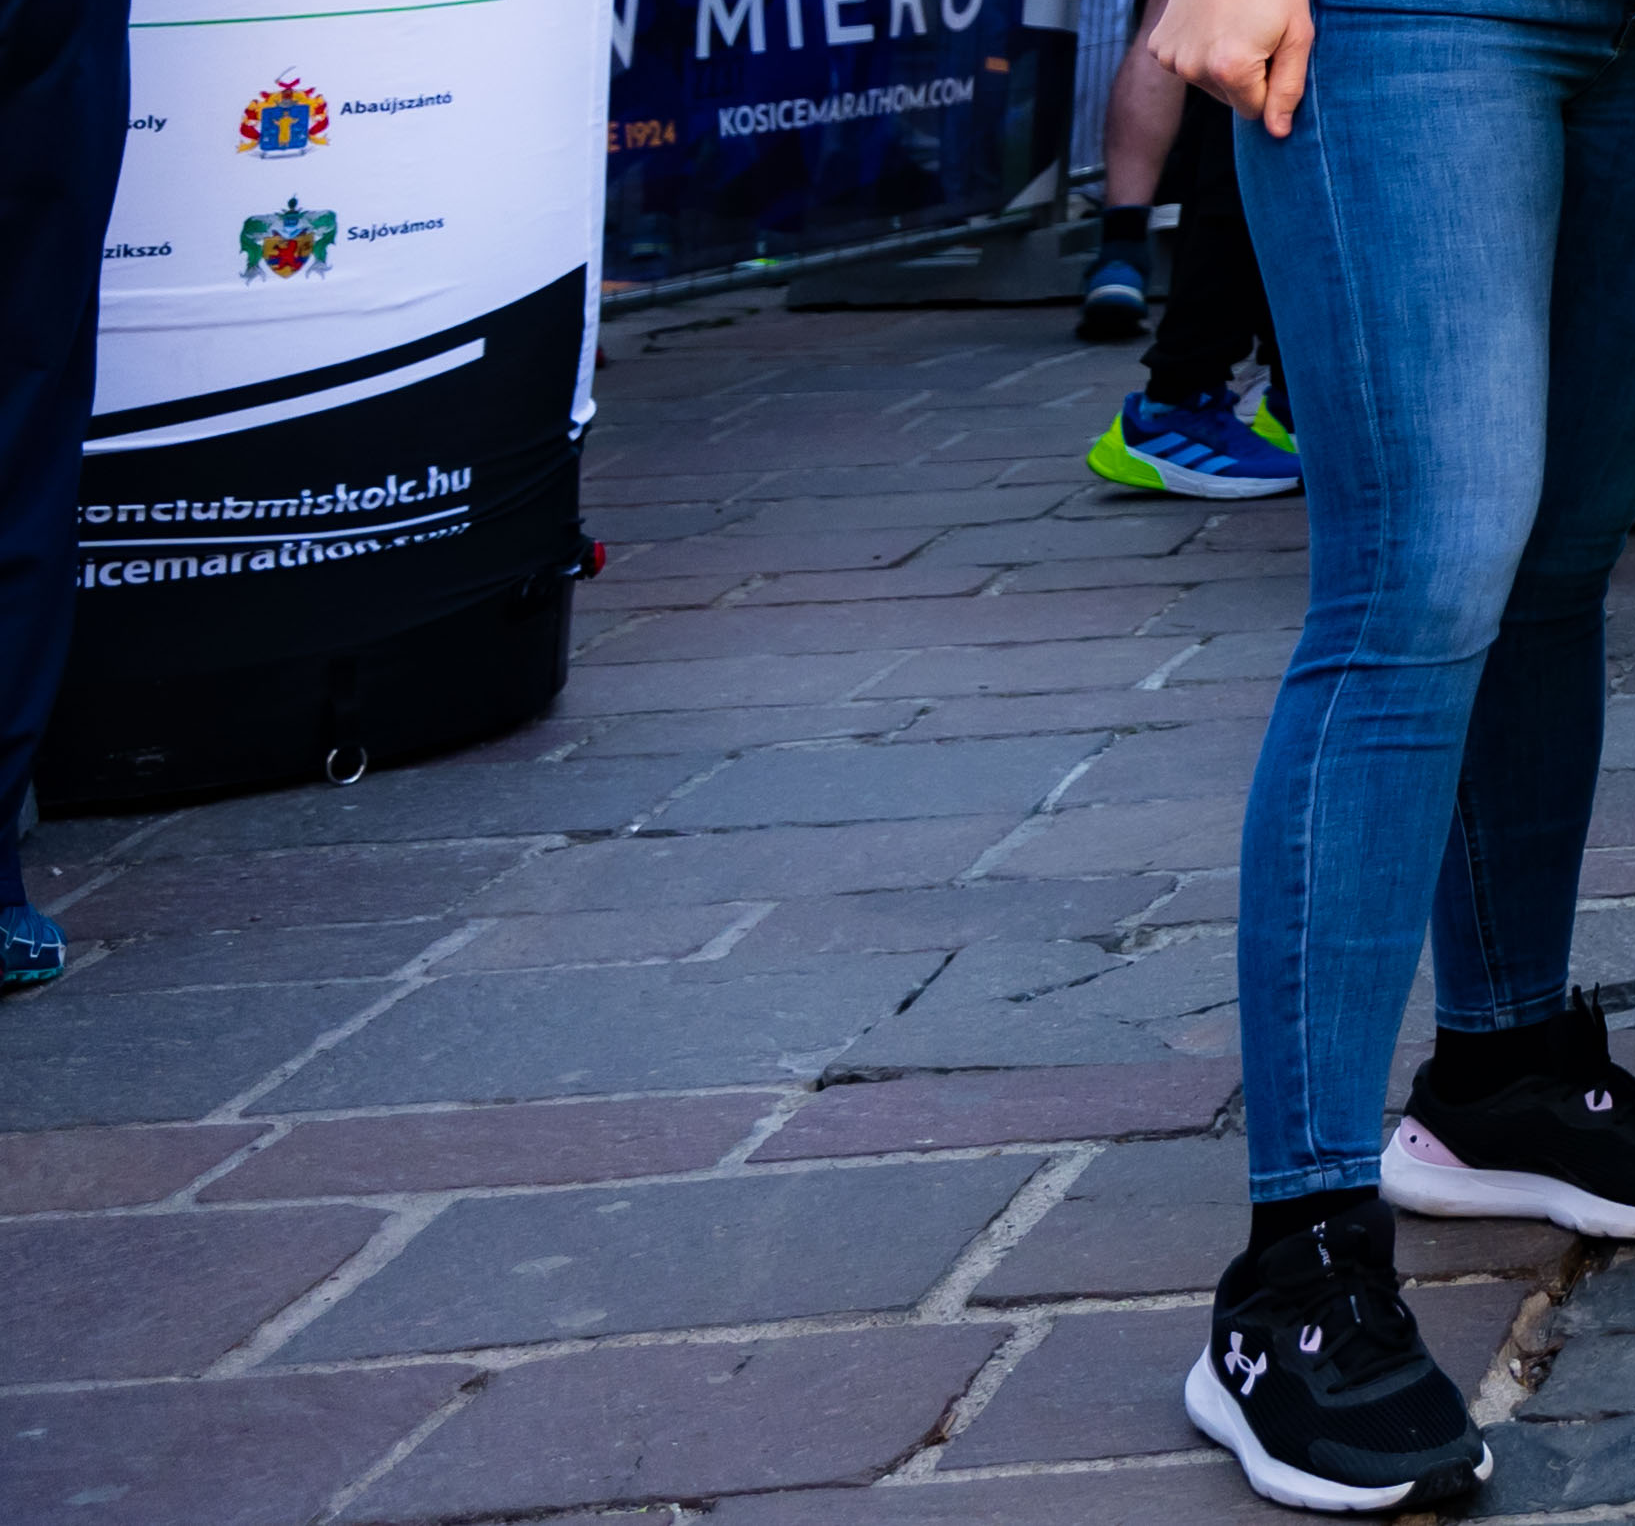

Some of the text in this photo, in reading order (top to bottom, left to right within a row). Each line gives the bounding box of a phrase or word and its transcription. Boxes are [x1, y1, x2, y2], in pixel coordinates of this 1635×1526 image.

[340, 91, 453, 116] Abaújszántó
[626, 120, 675, 149] 1924
[347, 217, 445, 243] Sajóvámos
[103, 243, 172, 259] zikszó
[77, 466, 472, 524] onclubmiskolc.hu
